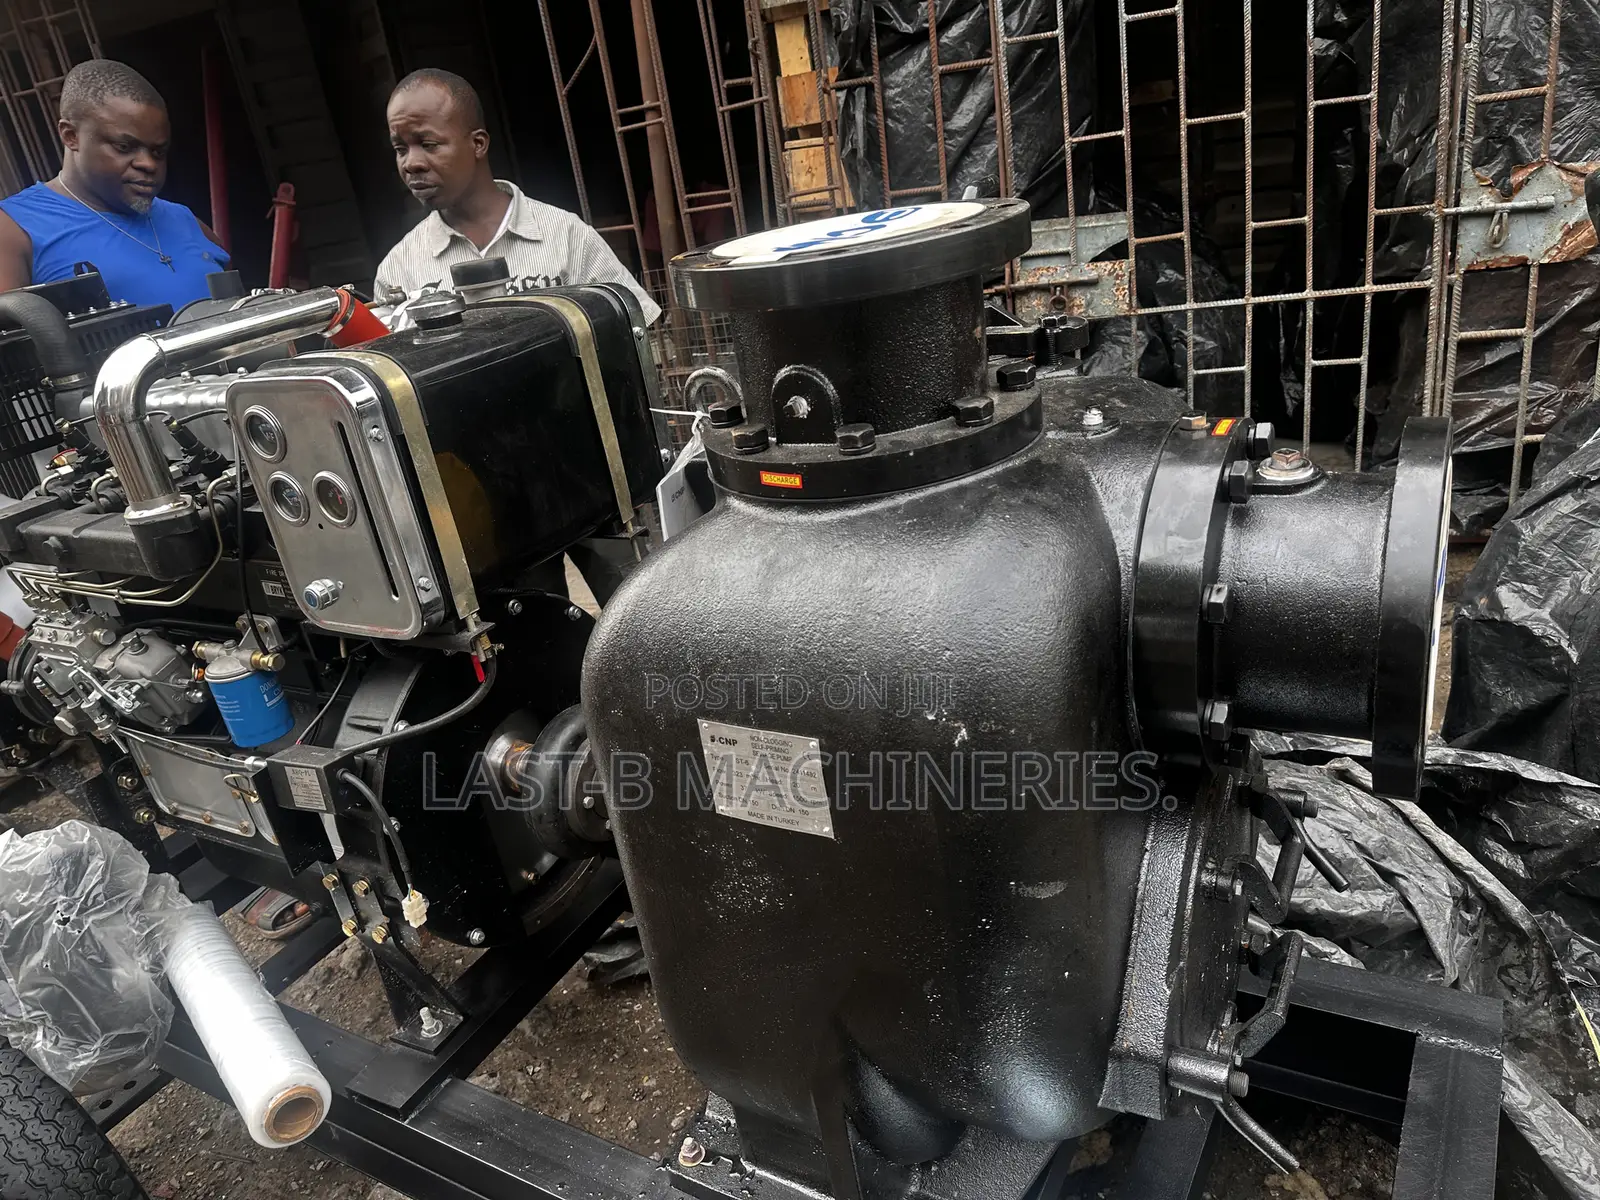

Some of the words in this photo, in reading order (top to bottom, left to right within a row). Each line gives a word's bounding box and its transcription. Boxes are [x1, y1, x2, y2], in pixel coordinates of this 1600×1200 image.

[763, 474, 798, 485] DISCHARGE
[718, 736, 738, 747] CNP
[747, 810, 765, 819] MADE
[774, 816, 800, 826] TURKEY
